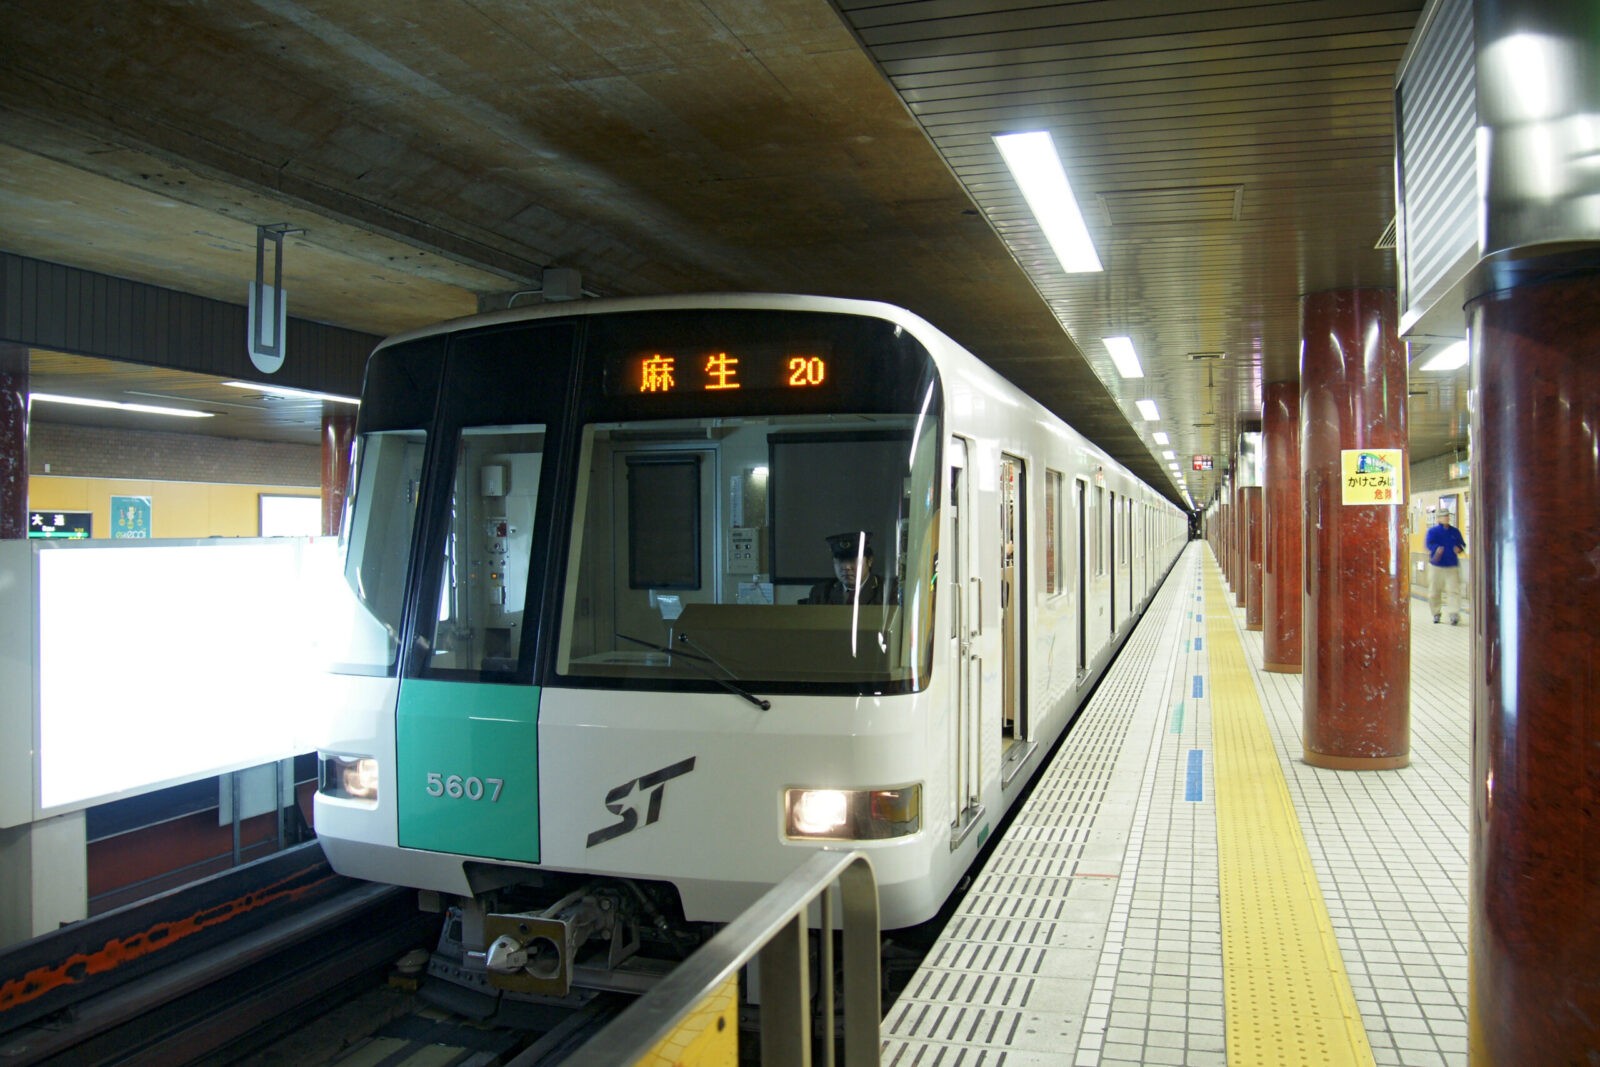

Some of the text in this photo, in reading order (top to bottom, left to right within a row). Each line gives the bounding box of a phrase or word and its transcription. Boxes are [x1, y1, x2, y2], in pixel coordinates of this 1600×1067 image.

[641, 354, 824, 391] 麻生 20
[426, 773, 504, 801] 5607
